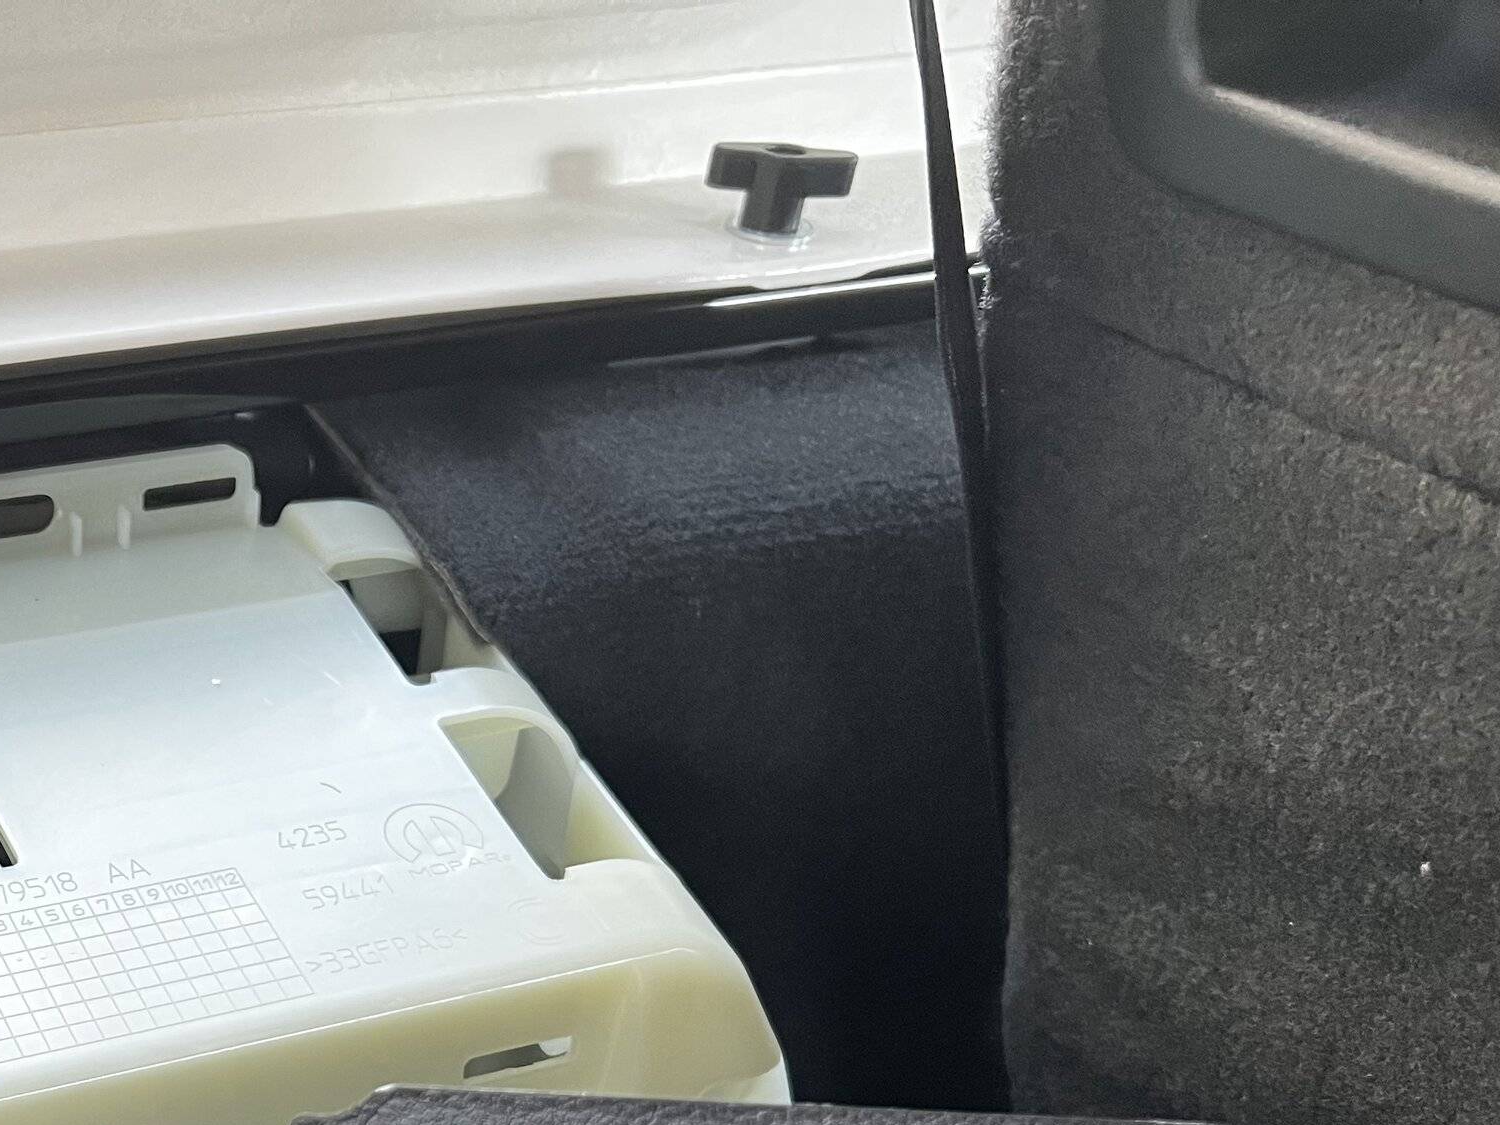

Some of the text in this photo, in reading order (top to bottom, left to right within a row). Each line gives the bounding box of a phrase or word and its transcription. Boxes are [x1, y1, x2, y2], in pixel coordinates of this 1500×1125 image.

[278, 820, 348, 850] 4235
[108, 858, 152, 884] AA
[20, 914, 34, 928] 4
[44, 908, 61, 922] 5
[71, 903, 86, 917] 6
[96, 897, 109, 911] 7
[121, 893, 137, 907] 8
[146, 887, 160, 901] 9
[164, 881, 189, 898] 10
[192, 876, 214, 892] 11
[215, 871, 241, 887] 12
[302, 873, 395, 911] 59441
